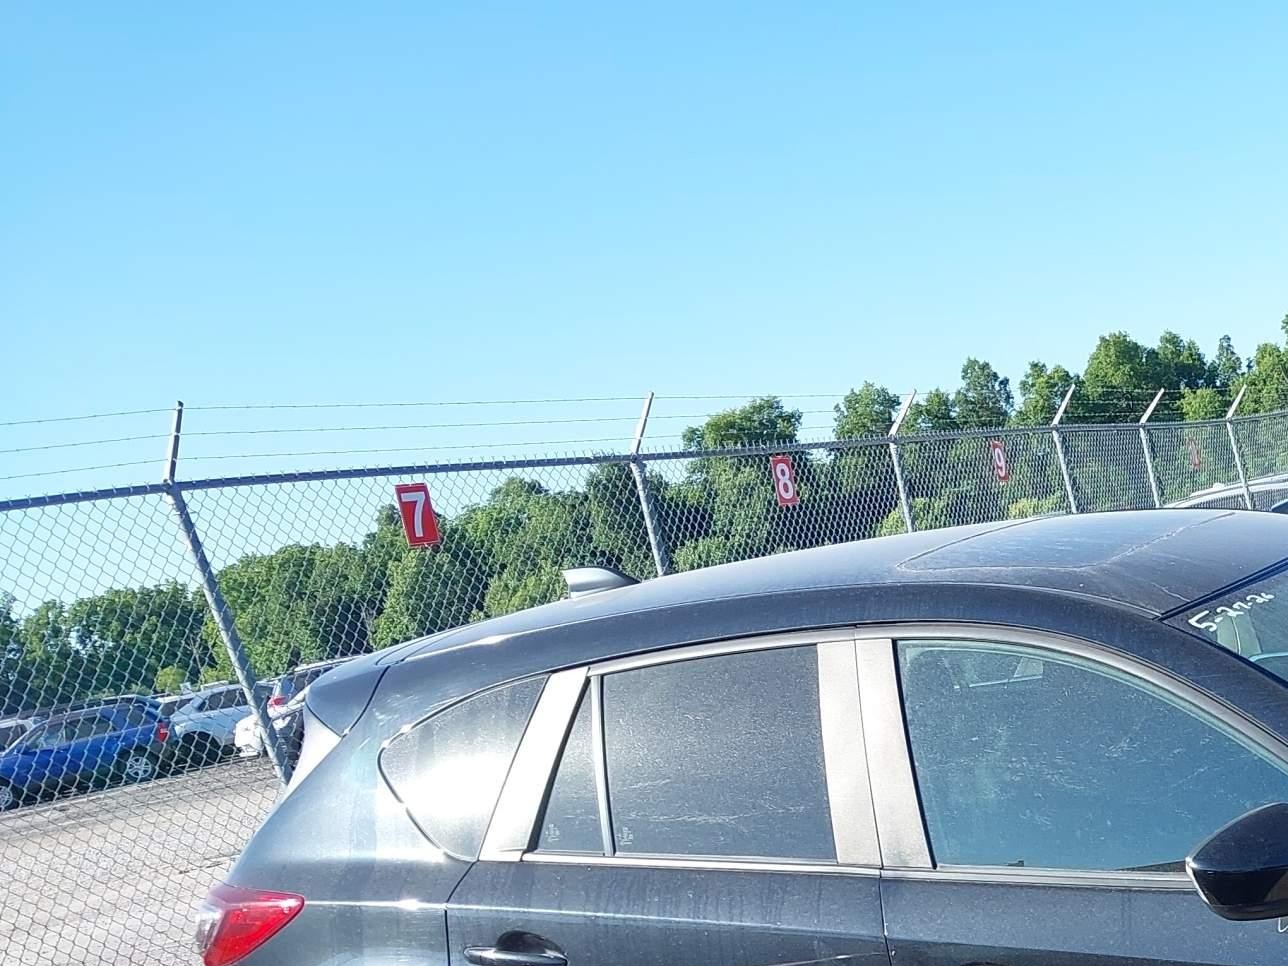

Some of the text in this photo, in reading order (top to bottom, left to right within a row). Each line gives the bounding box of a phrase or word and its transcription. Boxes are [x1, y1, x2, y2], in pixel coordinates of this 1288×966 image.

[995, 447, 1006, 477] 9
[776, 463, 794, 499] 8
[400, 491, 426, 538] 7
